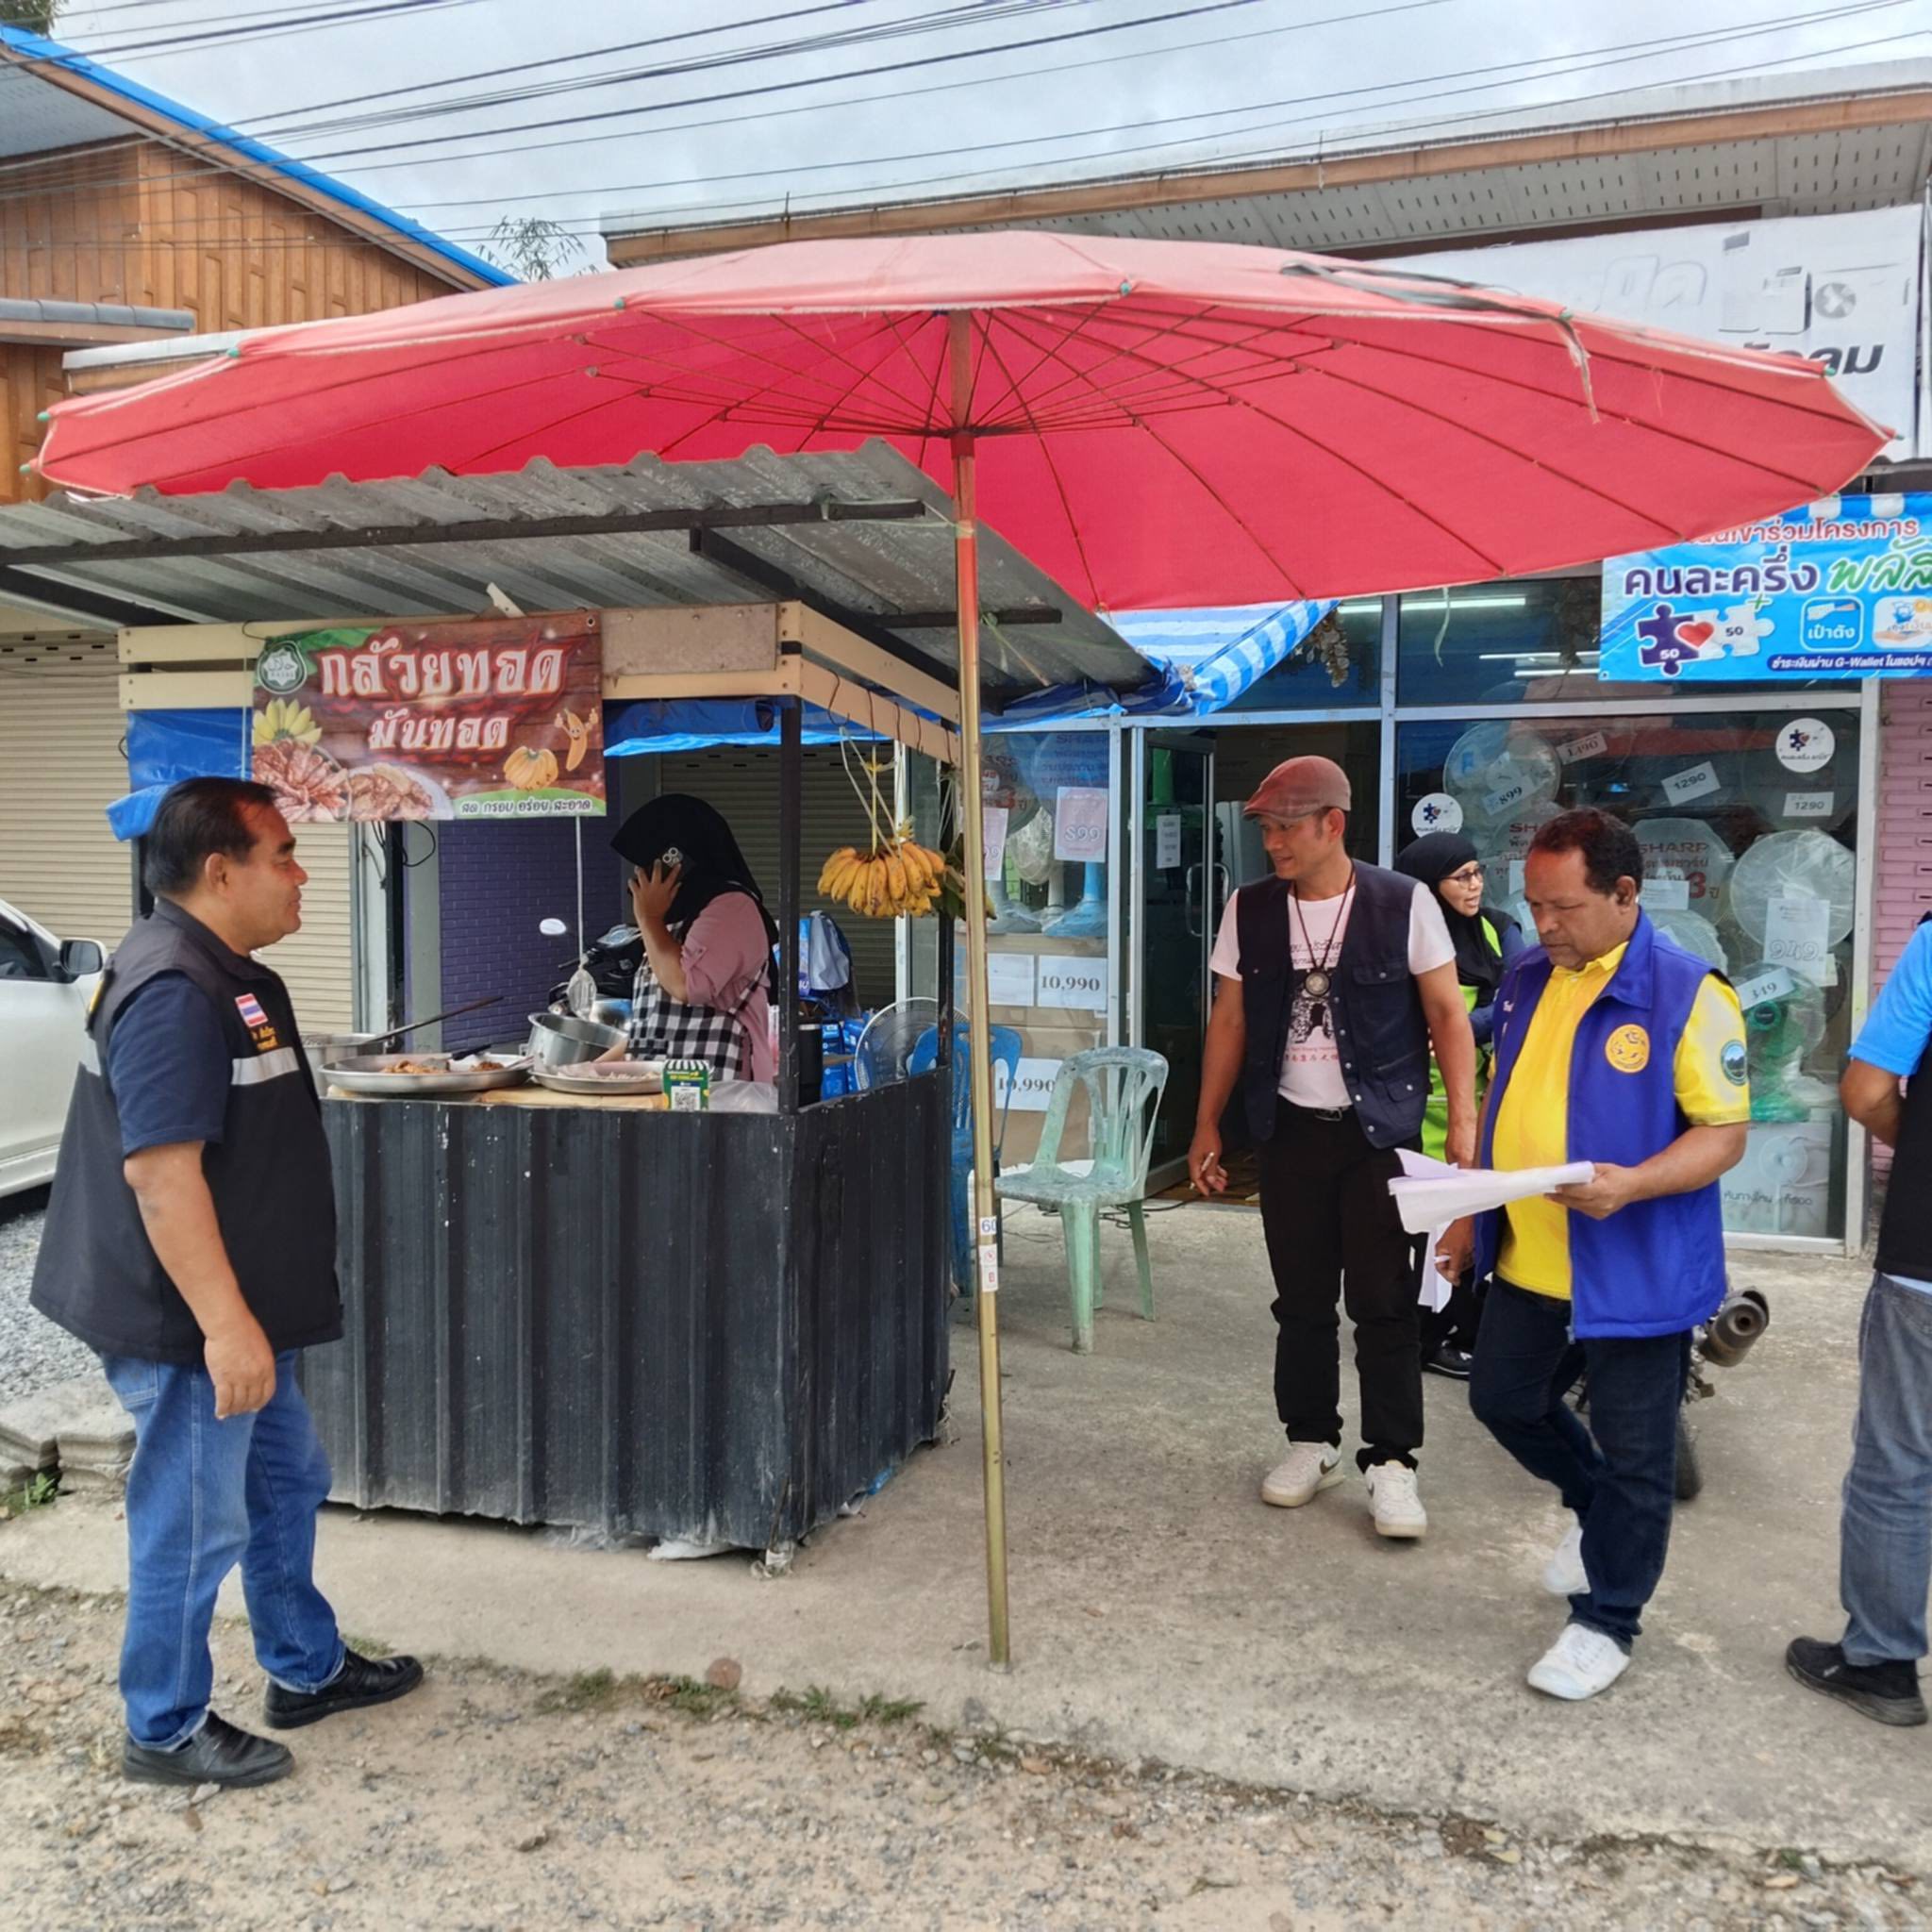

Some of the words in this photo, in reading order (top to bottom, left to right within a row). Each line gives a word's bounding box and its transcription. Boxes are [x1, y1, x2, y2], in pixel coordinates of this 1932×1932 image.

[1624, 545, 1818, 595] คนละครึ่ง
[1725, 625, 1744, 637] 50
[1659, 648, 1680, 660] 50
[321, 638, 565, 696] กล้วยทอด
[369, 707, 510, 751] มันทอด
[1673, 772, 1707, 791] 1290
[483, 800, 514, 813] กรอบ
[518, 798, 550, 812] อร่อย
[1794, 801, 1825, 810] 1290
[1041, 975, 1101, 991] 10,990
